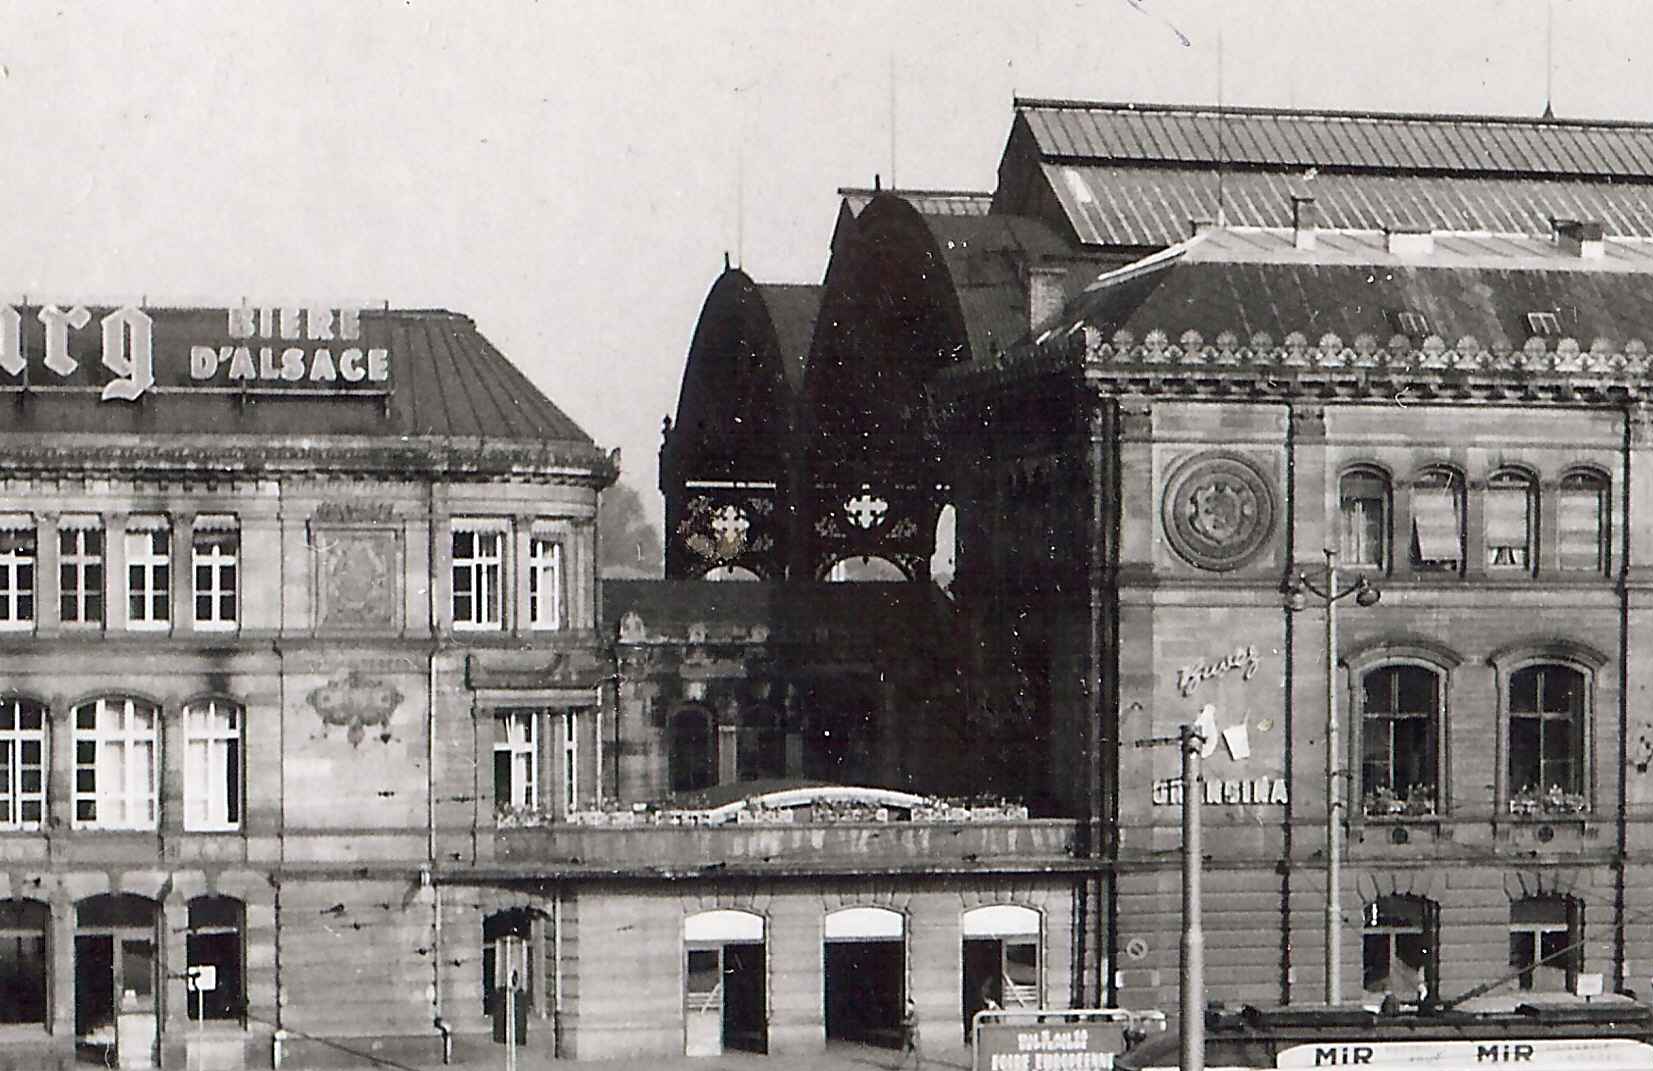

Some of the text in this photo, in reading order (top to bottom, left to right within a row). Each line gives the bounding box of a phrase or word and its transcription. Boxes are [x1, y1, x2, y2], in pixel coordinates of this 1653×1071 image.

[189, 345, 390, 382] D'ALSACE
[1314, 1047, 1375, 1067] MiR
[1477, 1044, 1535, 1063] MiR
